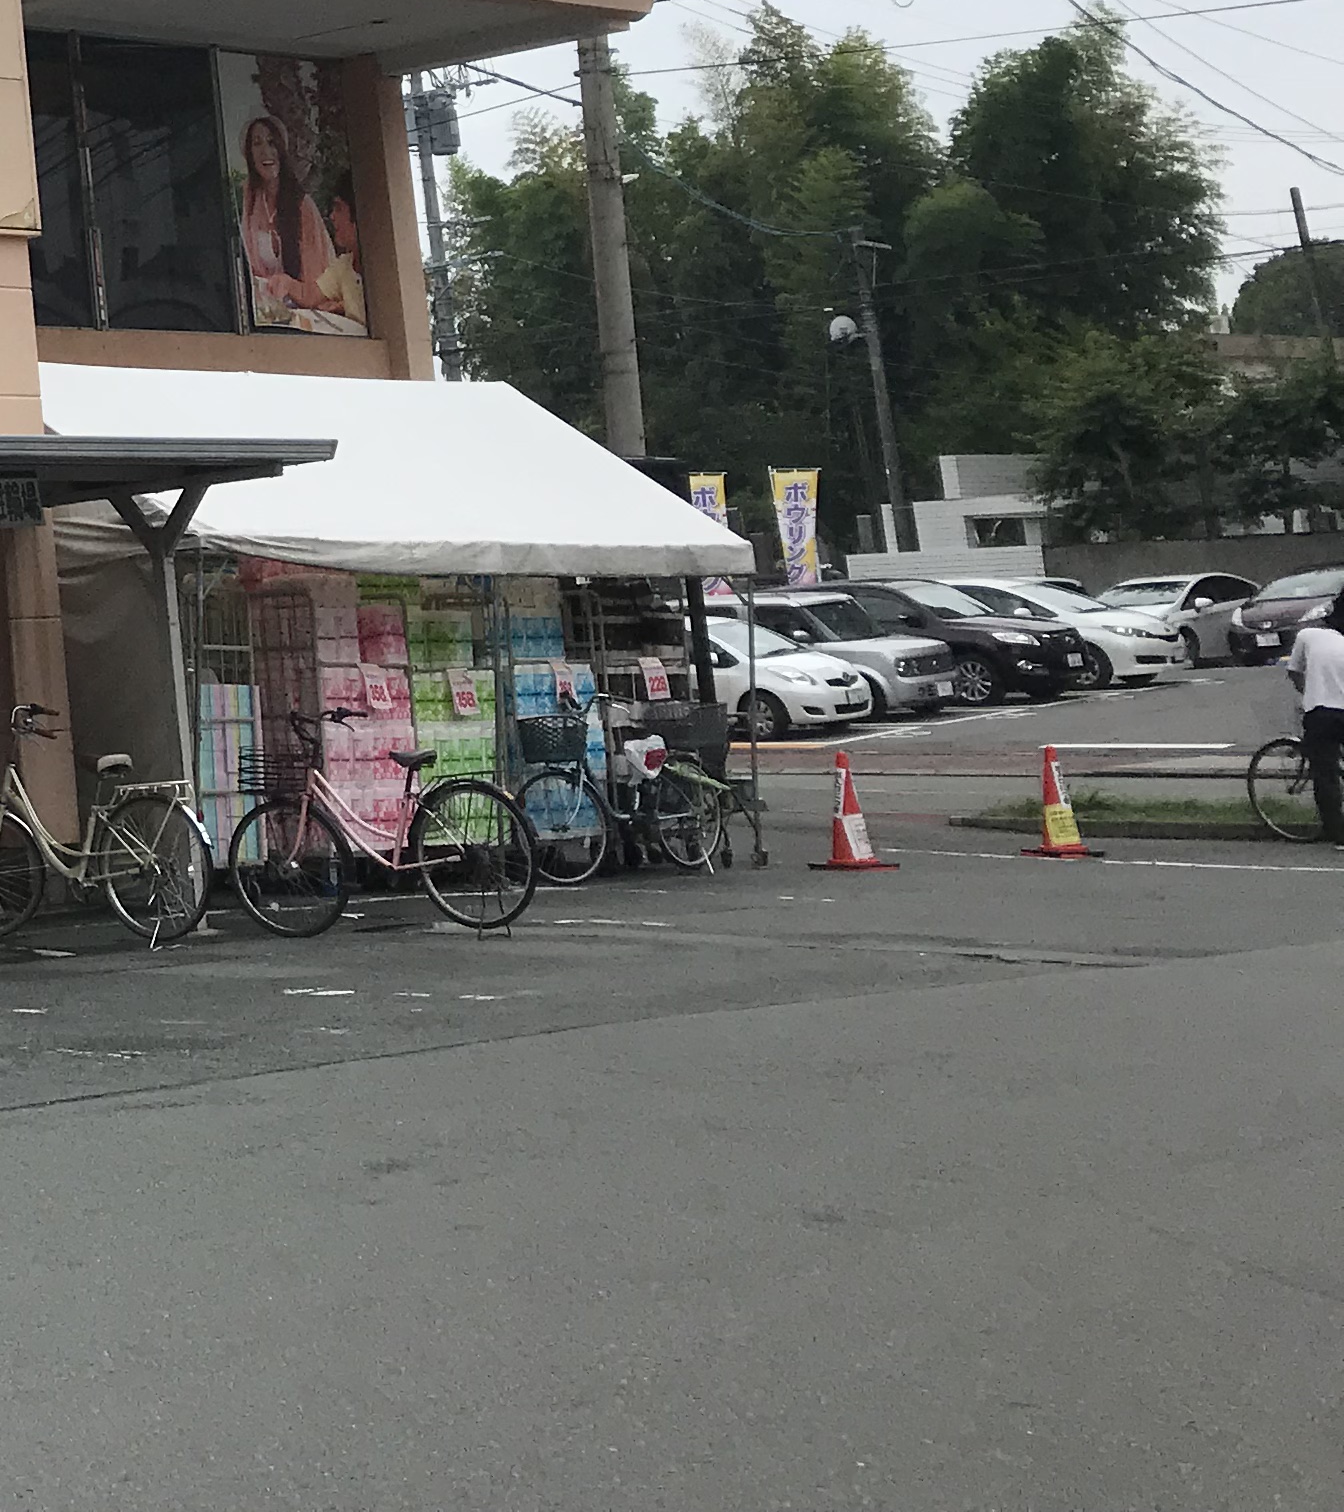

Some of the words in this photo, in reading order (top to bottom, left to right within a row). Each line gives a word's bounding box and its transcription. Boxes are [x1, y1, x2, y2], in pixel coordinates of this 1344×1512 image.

[785, 482, 808, 584] ボウリング
